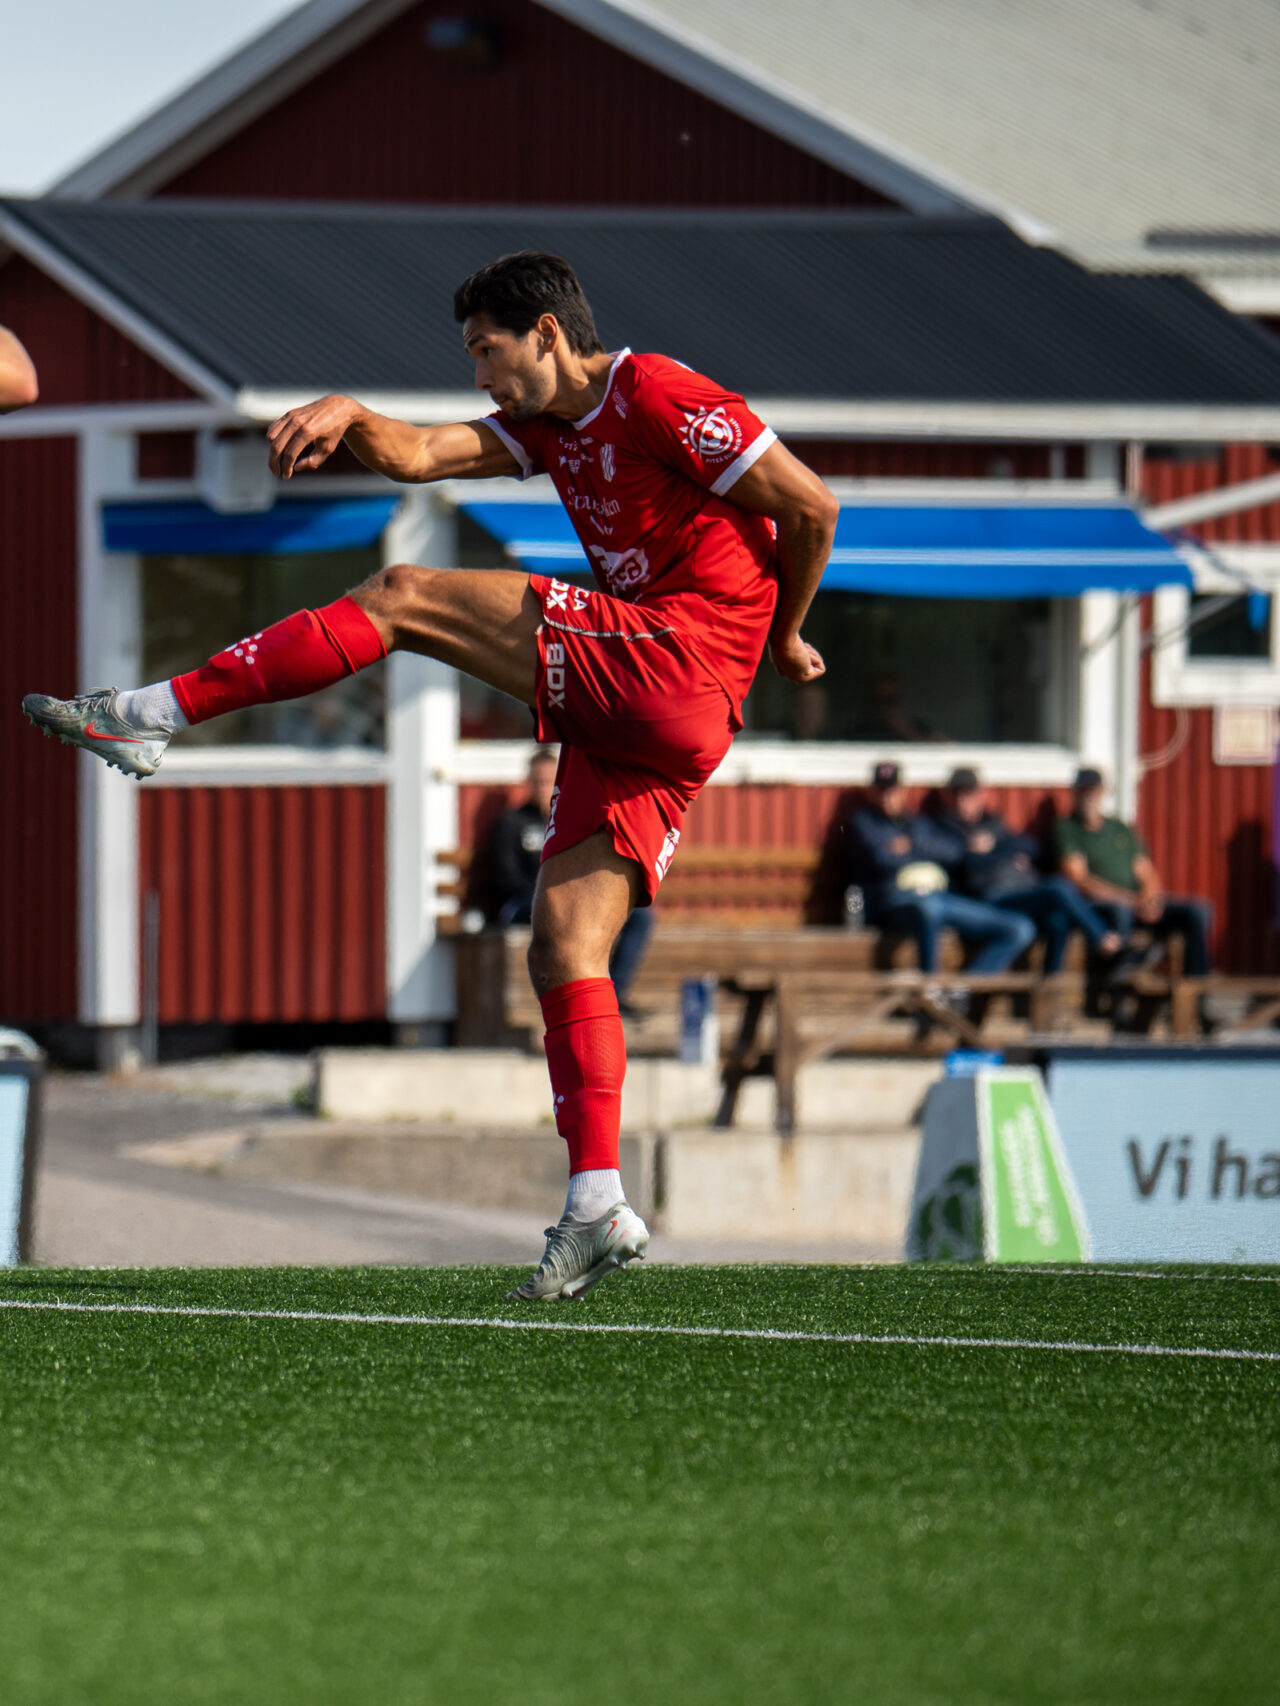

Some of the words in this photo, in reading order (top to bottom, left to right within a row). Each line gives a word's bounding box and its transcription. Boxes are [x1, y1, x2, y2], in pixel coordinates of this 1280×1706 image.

[546, 643, 565, 710] BOX
[1128, 1136, 1192, 1199] Vi
[1211, 1135, 1280, 1200] ha
